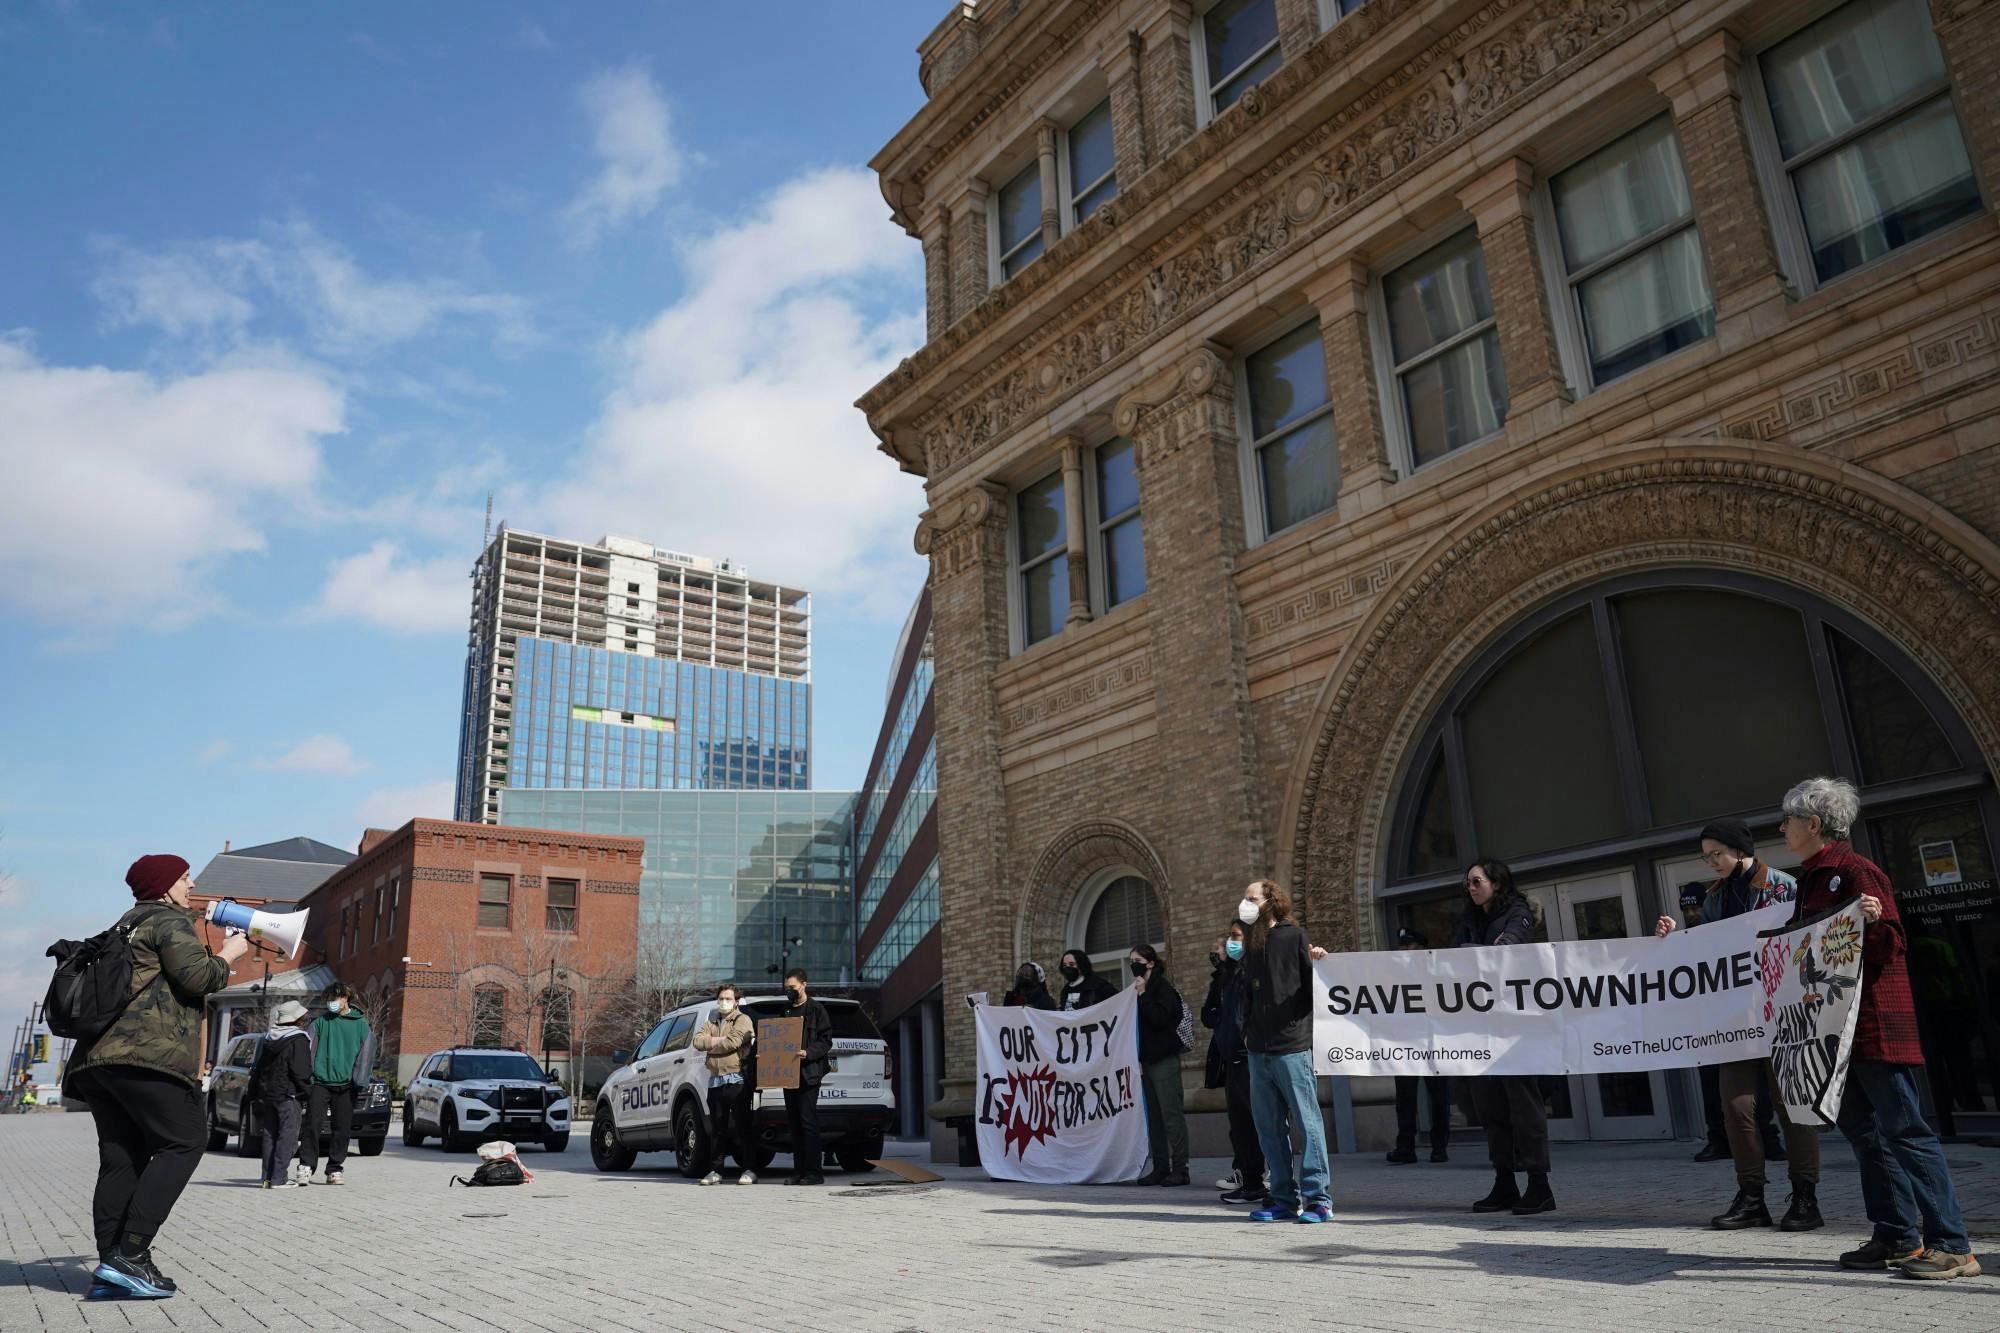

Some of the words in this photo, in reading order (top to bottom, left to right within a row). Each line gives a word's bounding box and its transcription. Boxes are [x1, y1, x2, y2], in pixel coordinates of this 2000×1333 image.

[1903, 887, 1932, 898] MAIN
[1934, 880, 1990, 895] BUILDING
[1967, 898, 1992, 907] Street
[1328, 984, 1426, 1015] SAVE
[1436, 980, 1495, 1013] UC
[837, 1041, 878, 1050] UNIVERSITY
[1000, 1026, 1040, 1063] OUR
[1056, 1015, 1118, 1064] CITY
[1593, 1026, 1765, 1056] SaveTheUCTownhomes
[1328, 1047, 1491, 1063] @SaveUCTownhomes
[622, 1081, 670, 1111] POLICE
[820, 1090, 848, 1098] LICE
[979, 1073, 1008, 1129] IS
[1008, 1079, 1051, 1132] NOT
[1053, 1081, 1086, 1130] FOR
